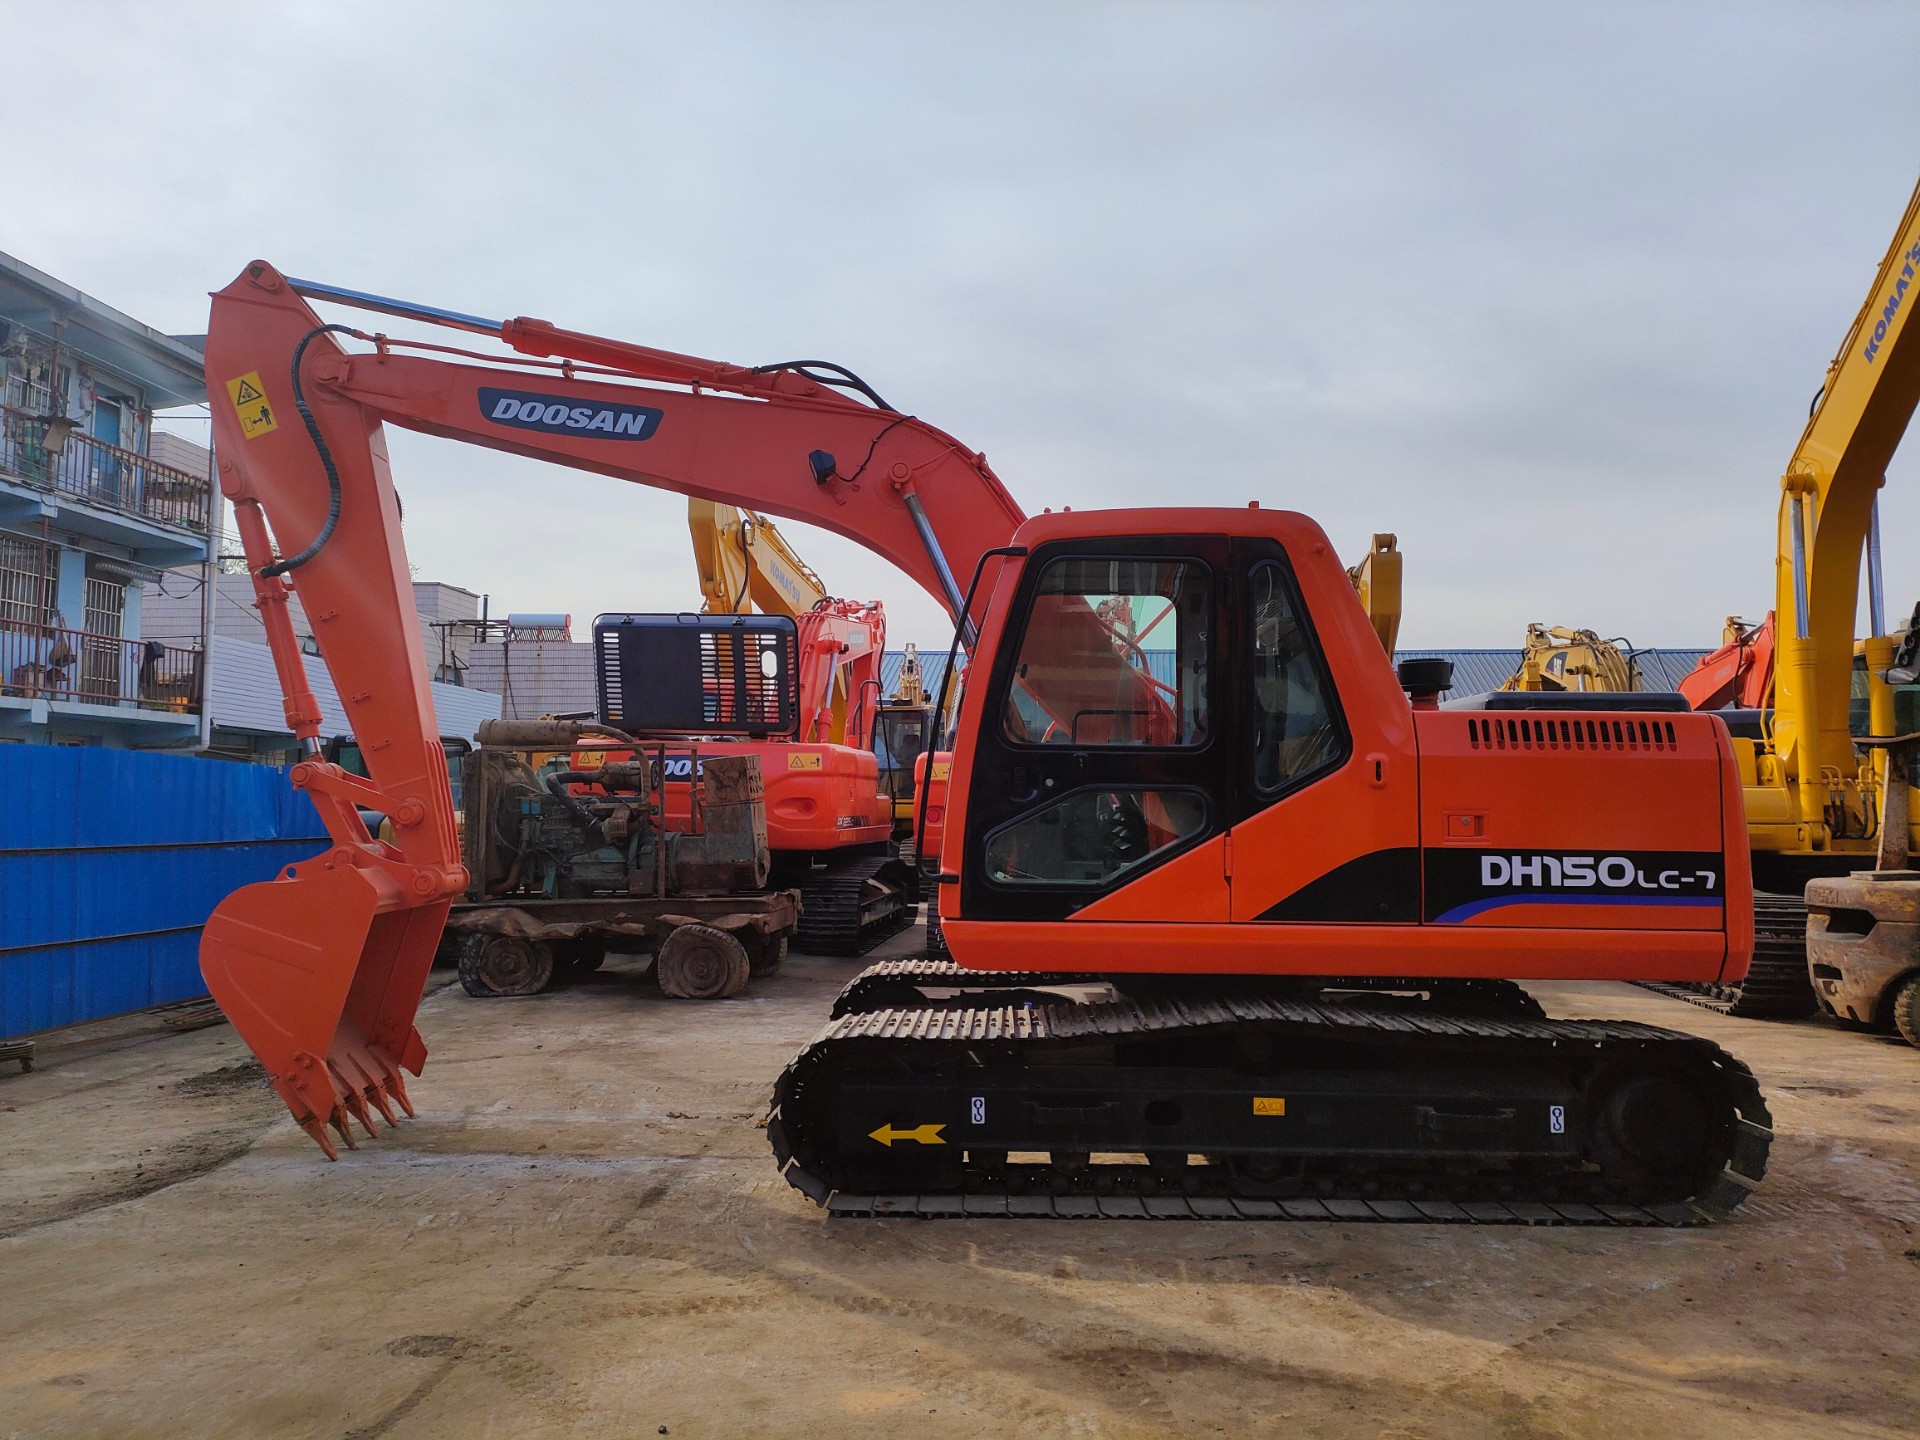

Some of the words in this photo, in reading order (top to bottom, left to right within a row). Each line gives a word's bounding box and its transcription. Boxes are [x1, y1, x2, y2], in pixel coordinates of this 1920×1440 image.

[1864, 235, 1920, 365] KOMATS
[491, 398, 647, 435] DOOSAN
[770, 559, 800, 604] KOMATSU
